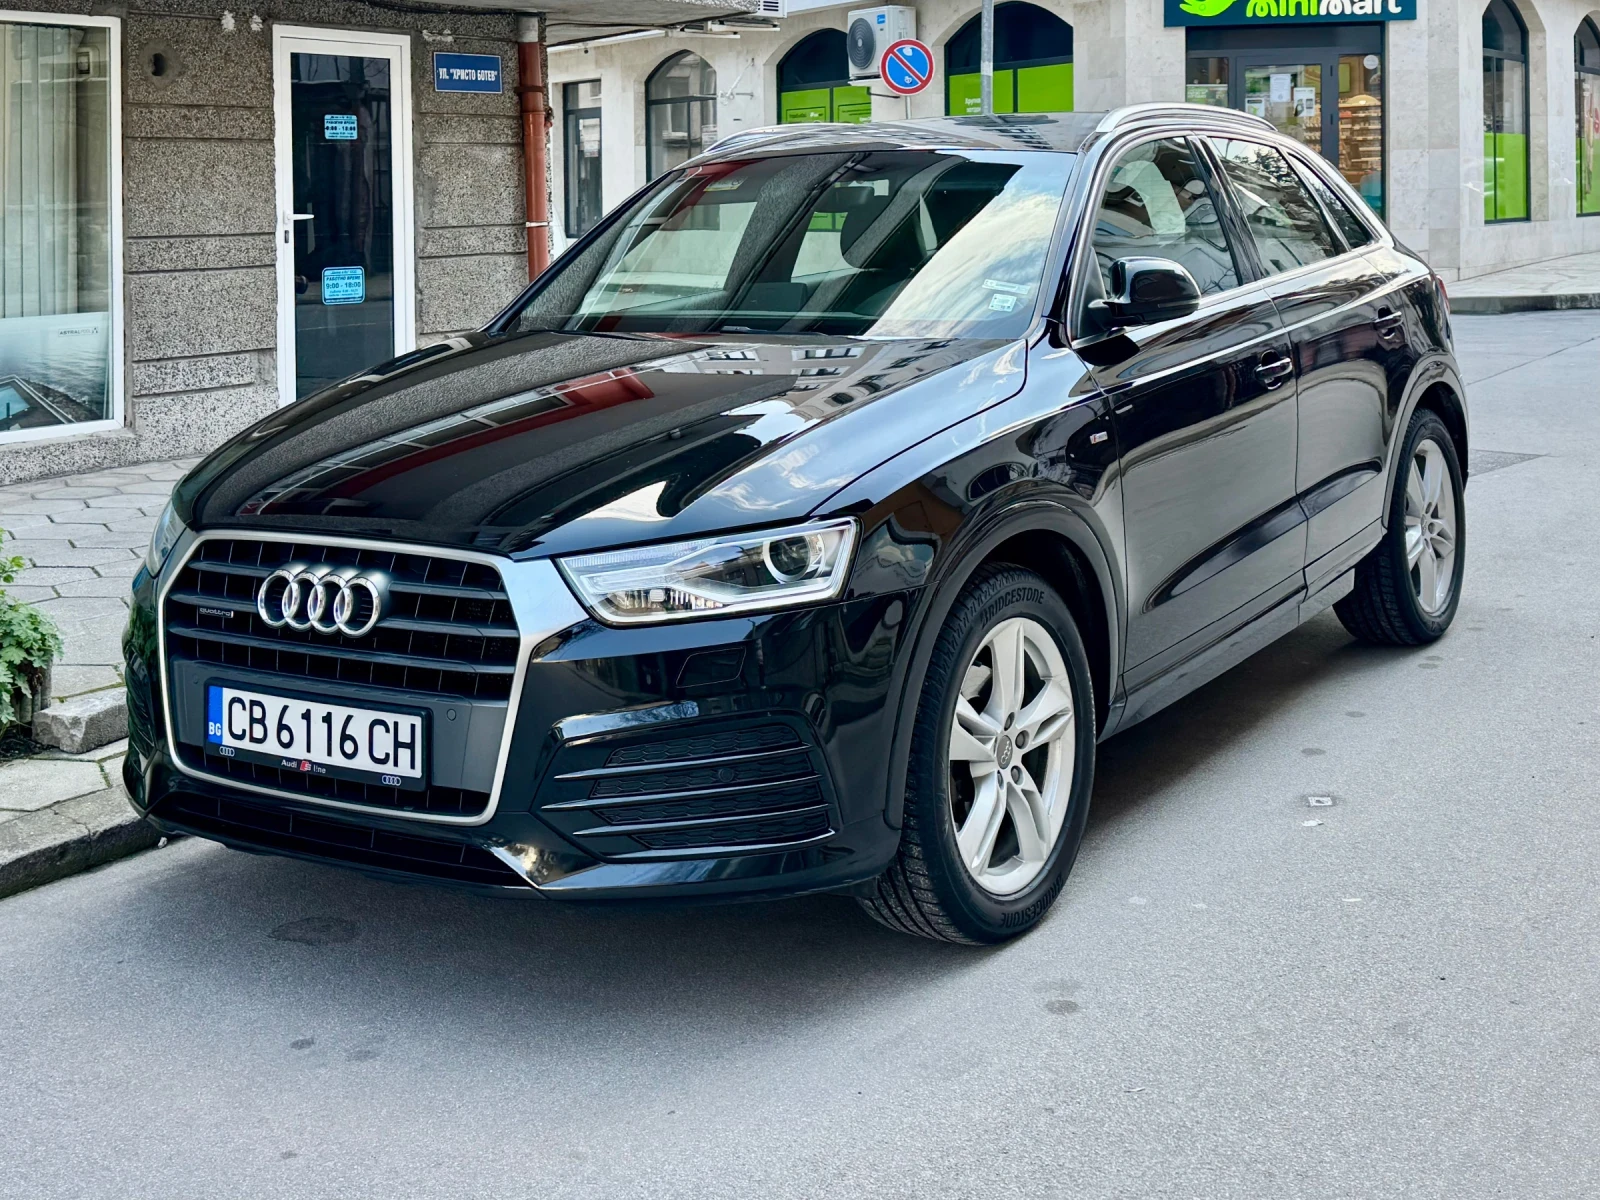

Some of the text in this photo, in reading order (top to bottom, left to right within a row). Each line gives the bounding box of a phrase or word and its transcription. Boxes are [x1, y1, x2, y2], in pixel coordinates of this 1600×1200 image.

[200, 608, 231, 617] quattro
[980, 587, 1044, 630] BRIDGESTONE
[209, 722, 221, 736] BG
[281, 759, 298, 768] Audi
